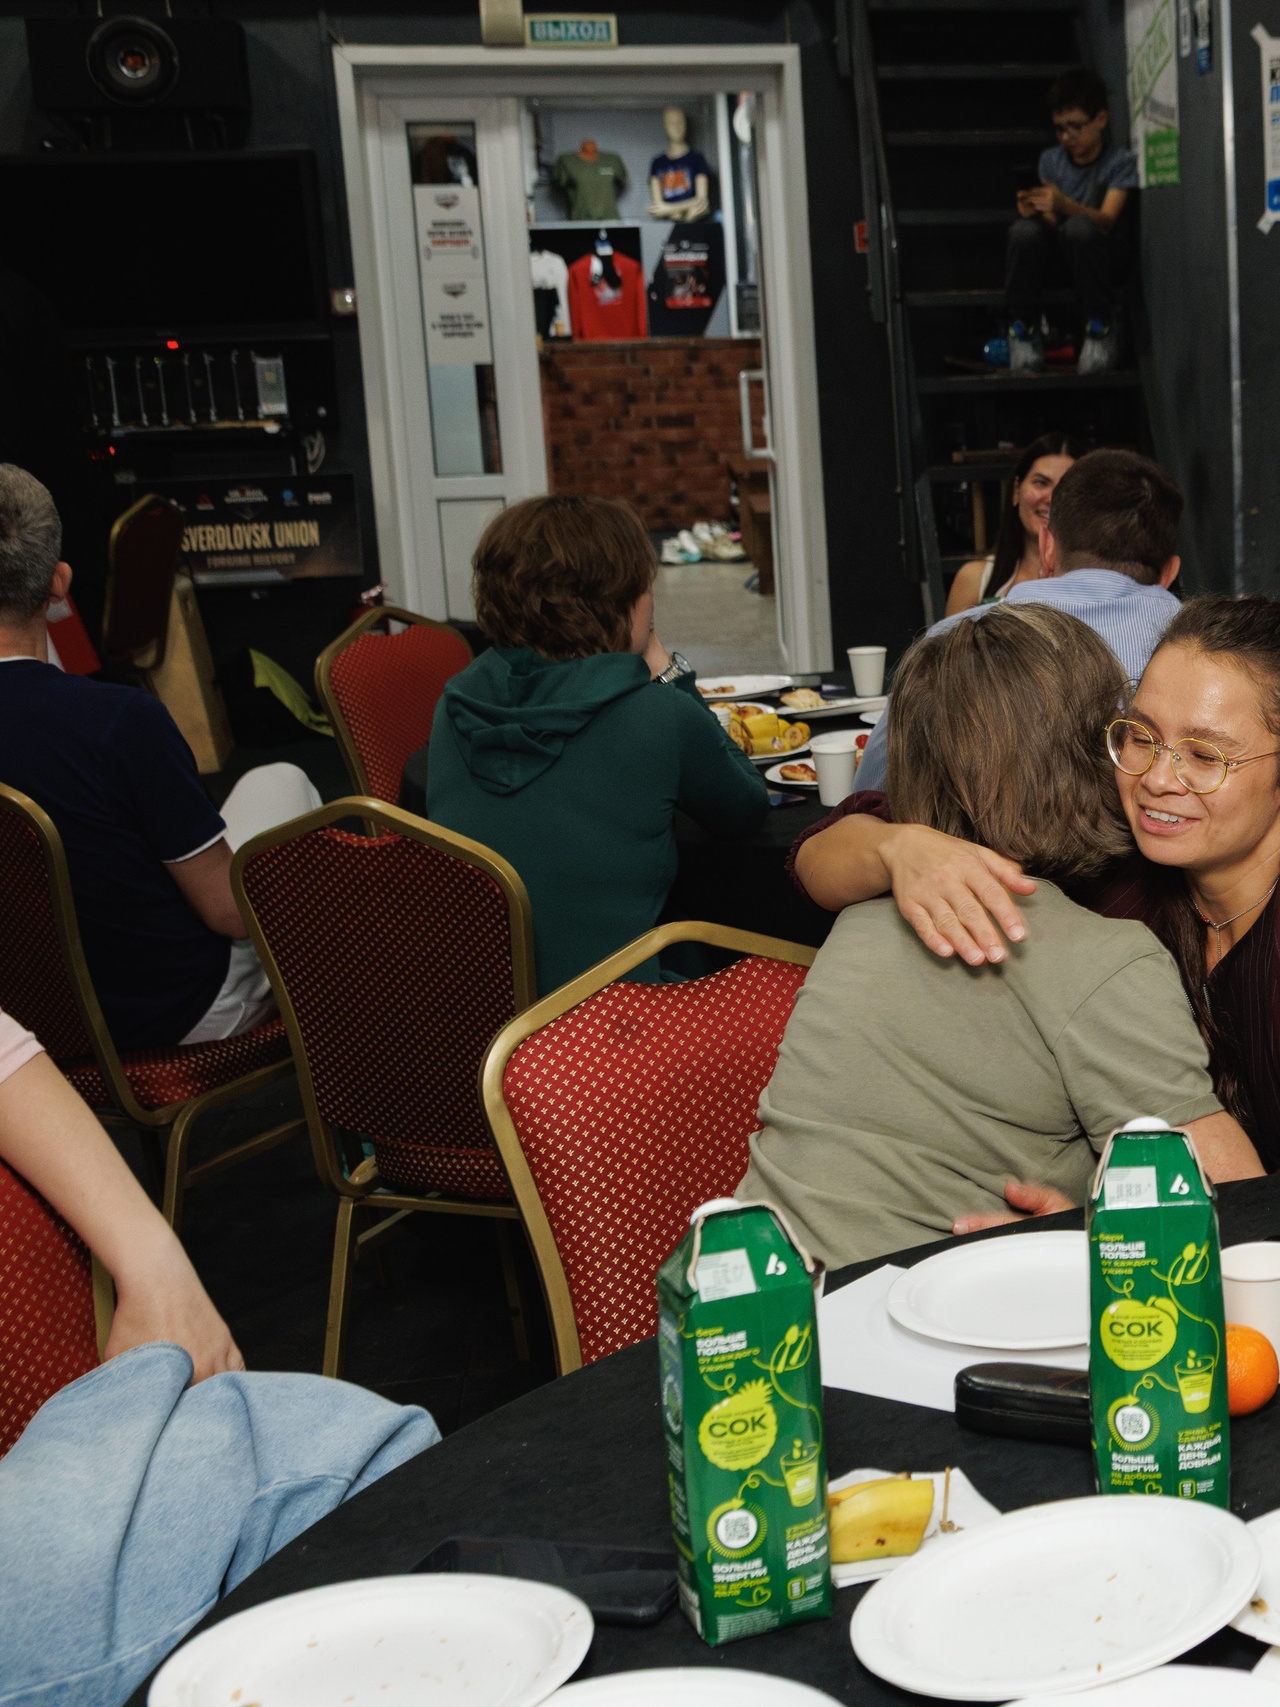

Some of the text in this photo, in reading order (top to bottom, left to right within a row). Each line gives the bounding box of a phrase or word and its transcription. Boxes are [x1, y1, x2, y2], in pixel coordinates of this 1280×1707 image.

[534, 20, 608, 40] ВЫХОД
[181, 519, 321, 552] SVERDLOVSK UNION
[1099, 1233, 1124, 1242] бери
[1099, 1240, 1146, 1252] БОЛЬШЕ
[1100, 1250, 1146, 1260] ПОЛЬЗЫ
[1113, 1258, 1158, 1268] каждого
[696, 1327, 724, 1338] бери
[1109, 1320, 1164, 1338] СОК
[696, 1331, 747, 1348] БОЛЬШЕ
[696, 1340, 747, 1357] ПОЛЬЗЫ
[712, 1348, 761, 1363] каждого
[708, 1413, 767, 1438] СОК
[1178, 1434, 1222, 1453] КАЖДЫЙ
[1111, 1452, 1155, 1464] БОЛЬШЕ
[1178, 1450, 1208, 1462] ДЕНЬ
[1178, 1453, 1222, 1471] ДОБРЫМ
[1111, 1463, 1159, 1473] ЭНЕРГИИ
[1123, 1471, 1162, 1481] добрые
[787, 1543, 816, 1559] ДЕНЬ
[712, 1557, 763, 1574] БОЛЬШЕ
[713, 1566, 767, 1583] ЭНЕРГИИ
[729, 1576, 770, 1590] добрые
